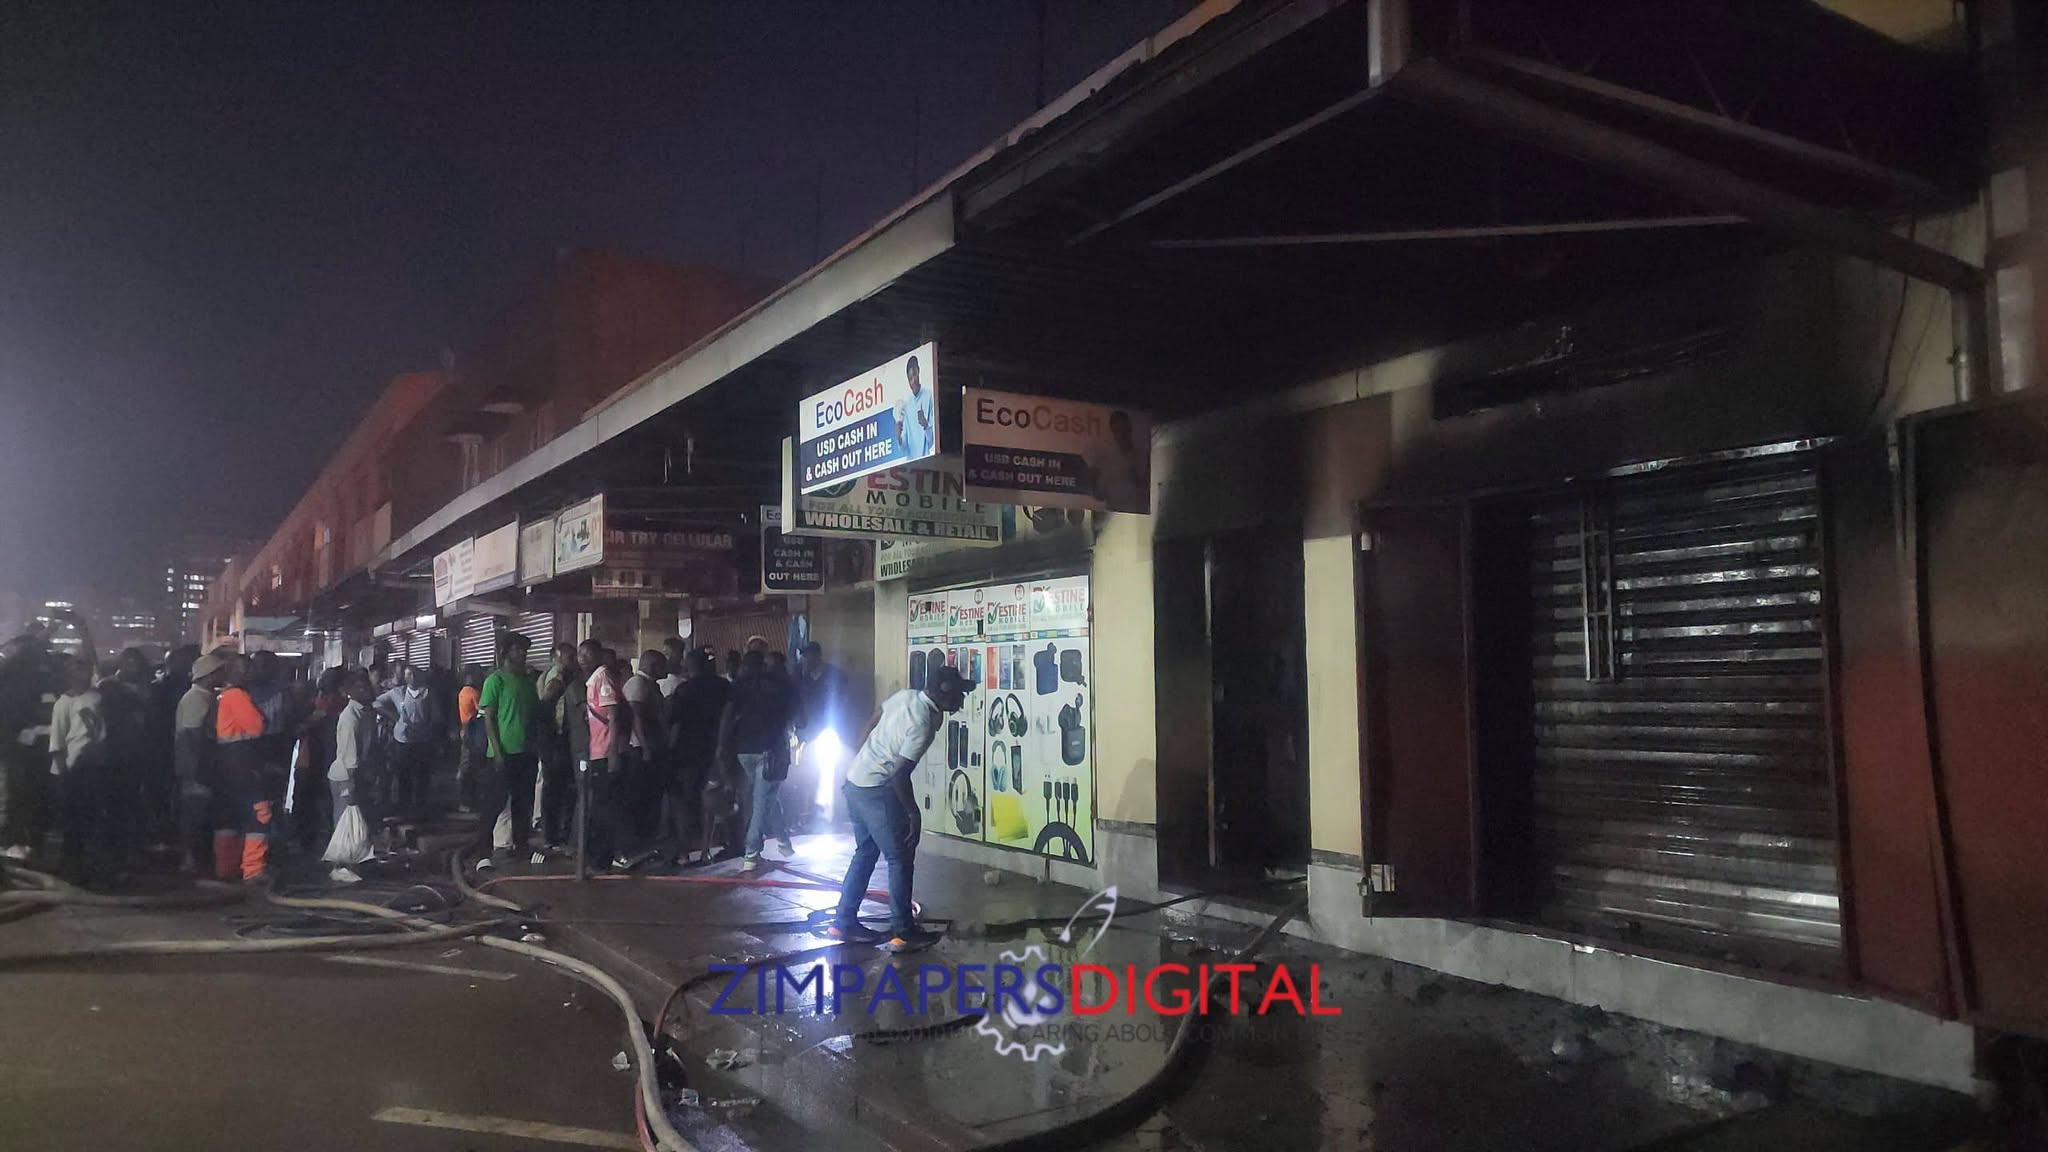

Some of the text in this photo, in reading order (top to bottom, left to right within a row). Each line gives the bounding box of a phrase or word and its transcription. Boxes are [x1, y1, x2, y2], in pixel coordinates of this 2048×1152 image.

[815, 377, 885, 429] EcoCash
[976, 397, 1101, 437] EcoCash
[816, 422, 878, 458] USD CASH IN
[805, 438, 892, 481] & CASH OUT HERE
[984, 452, 1061, 471] USD CASH IN
[980, 470, 1014, 482] CASH
[1017, 473, 1042, 485] OUT
[1045, 475, 1077, 488] HERE
[840, 503, 862, 514] ALL
[865, 489, 986, 514] MOBILE
[804, 511, 989, 539] WHOLESALE & RETAIL
[663, 531, 733, 549] CELLULAR
[773, 549, 801, 558] CASH
[785, 560, 813, 568] CASH
[880, 559, 912, 577] WHOLES
[768, 572, 820, 582] OUT HERE
